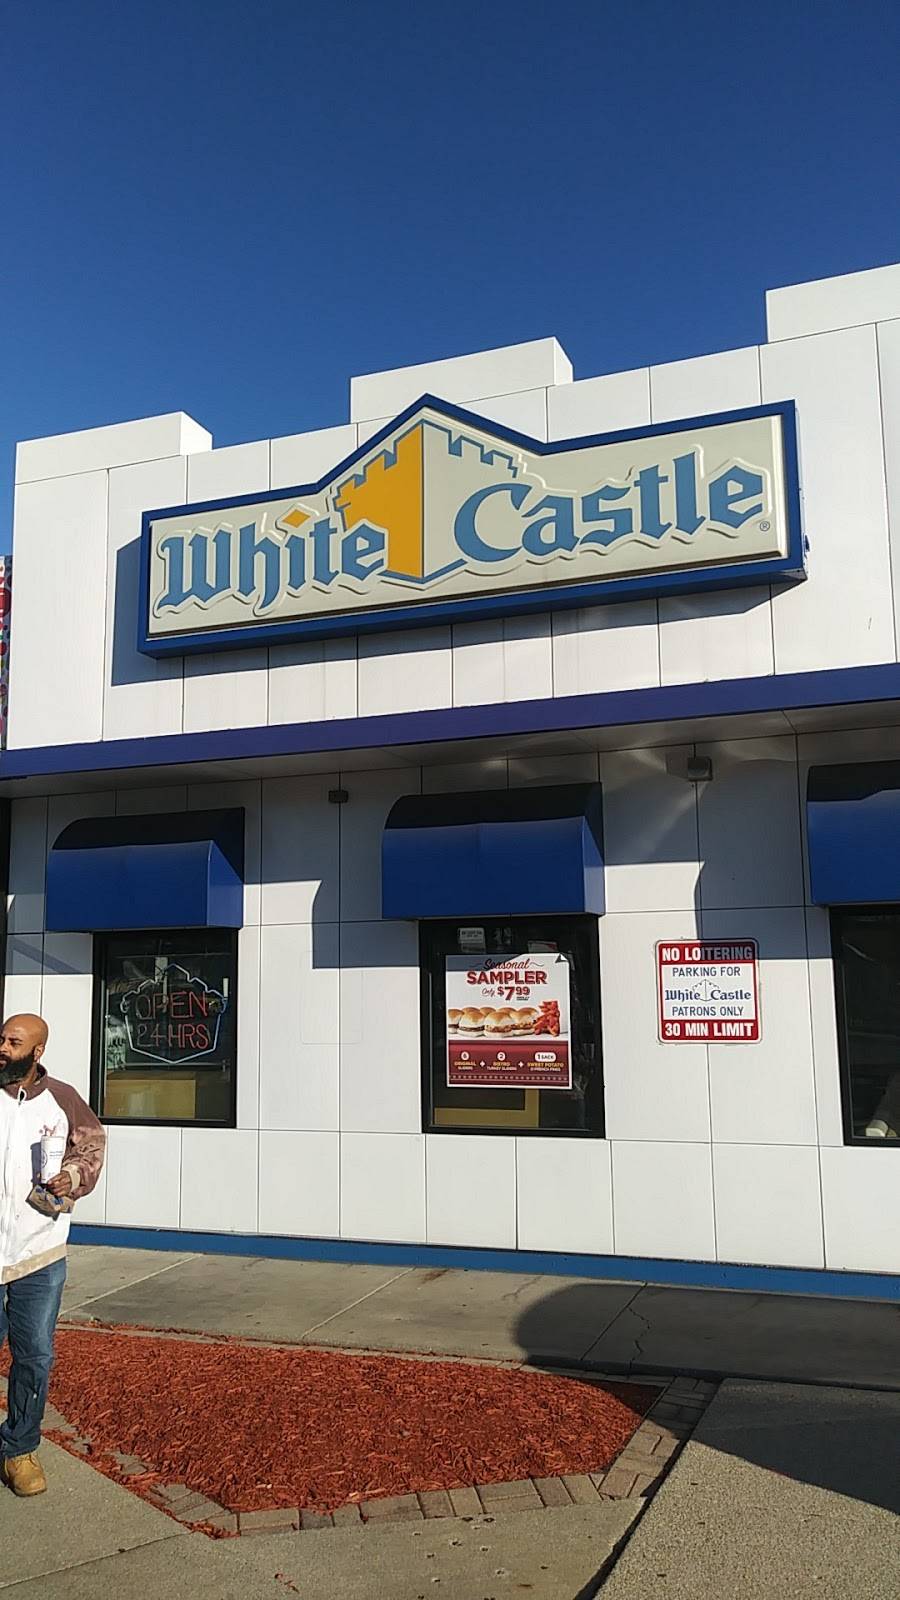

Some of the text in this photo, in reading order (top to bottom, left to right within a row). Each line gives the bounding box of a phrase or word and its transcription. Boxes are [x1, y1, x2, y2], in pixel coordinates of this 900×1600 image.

[157, 449, 763, 613] White Castle
[662, 946, 753, 961] NO LOITERING
[483, 958, 531, 971] Seasonal
[672, 966, 741, 977] PARKING FOR
[466, 971, 548, 985] SAMPLER
[481, 988, 496, 998] Only
[665, 989, 752, 1002] White Castle
[135, 990, 208, 1020] OPEN
[672, 1006, 744, 1016] PATRONS ONLY
[137, 1023, 209, 1049] 24 HRS
[665, 1022, 754, 1037] 30 MIN LIMIT
